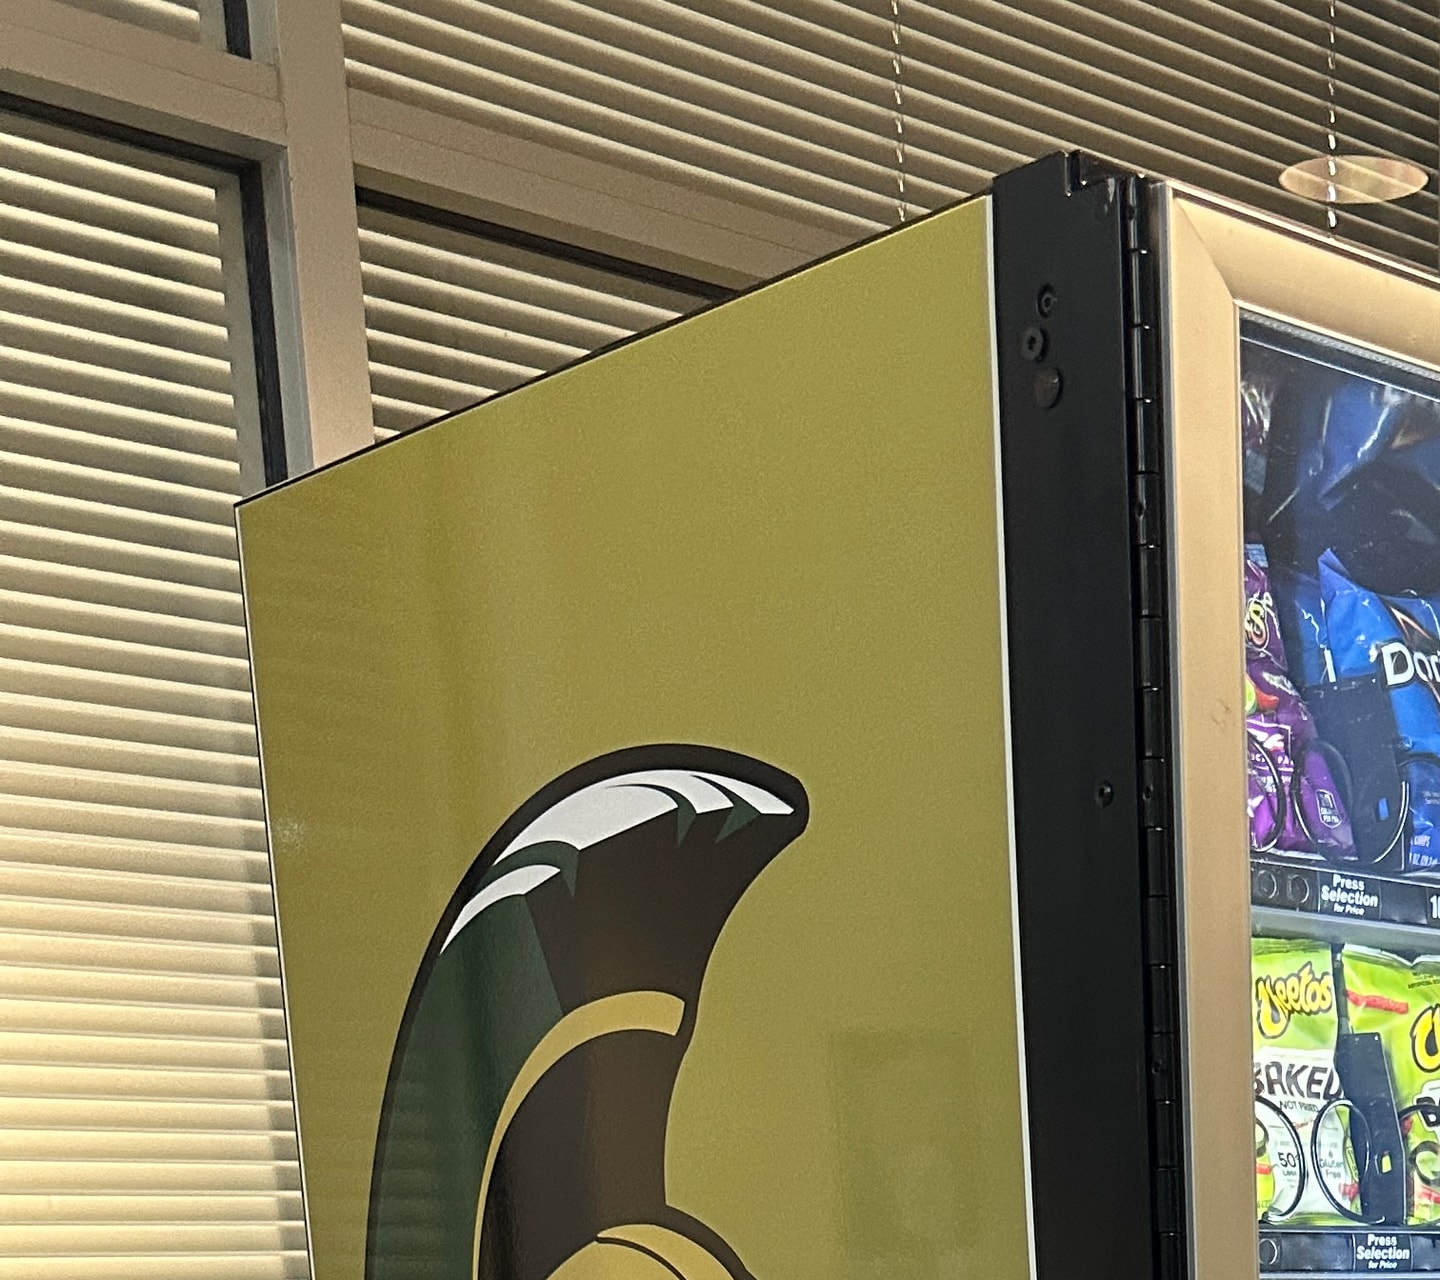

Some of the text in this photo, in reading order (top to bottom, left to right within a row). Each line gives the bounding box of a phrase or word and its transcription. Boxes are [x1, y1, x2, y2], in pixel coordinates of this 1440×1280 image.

[1332, 873, 1366, 891] Press
[1320, 886, 1379, 908] Selection
[1255, 961, 1335, 1039] Cheetos
[1279, 1099, 1298, 1112] NOT
[1367, 1233, 1398, 1247] Press
[1356, 1244, 1410, 1261] Selection
